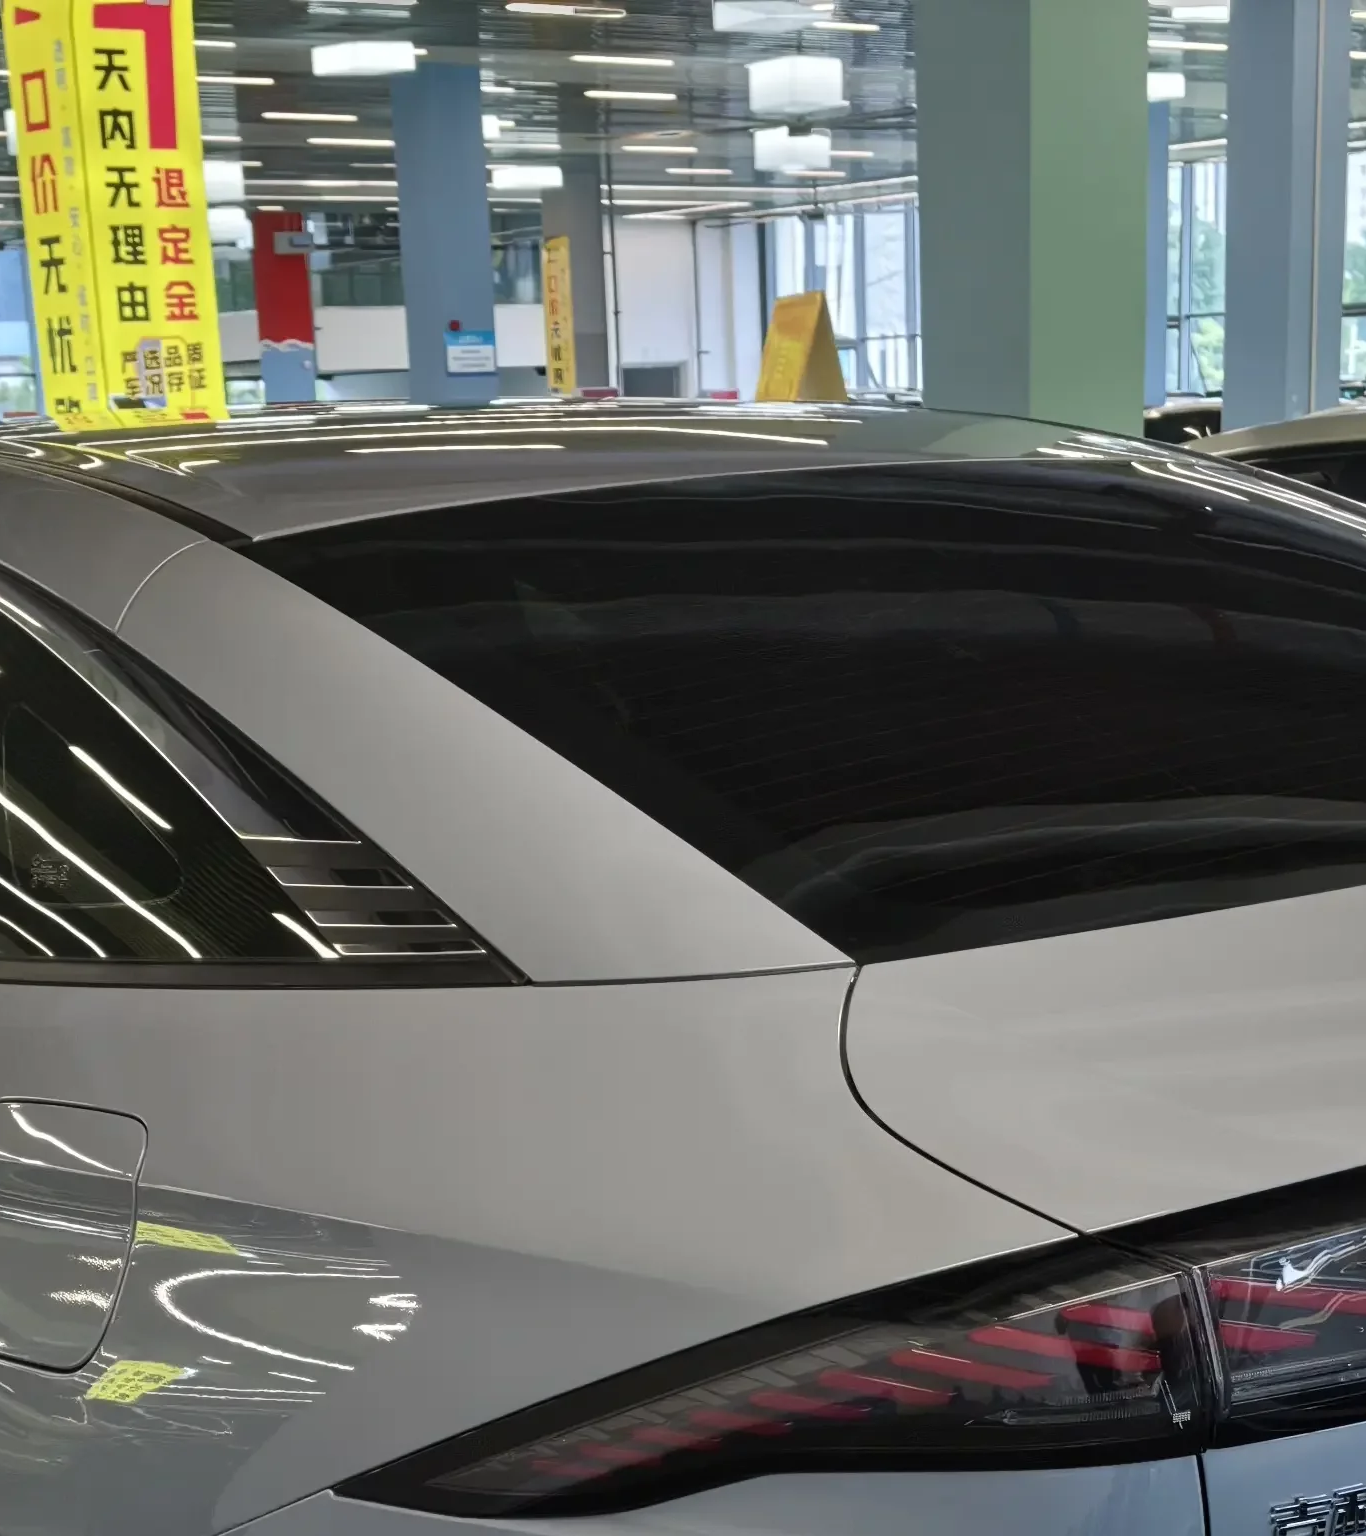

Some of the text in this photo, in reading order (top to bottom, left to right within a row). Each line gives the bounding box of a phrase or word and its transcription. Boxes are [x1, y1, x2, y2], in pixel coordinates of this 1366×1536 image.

[13, 6, 83, 415] 一口价无忧
[93, 47, 150, 322] 天内无理由
[152, 167, 199, 322] 退定金
